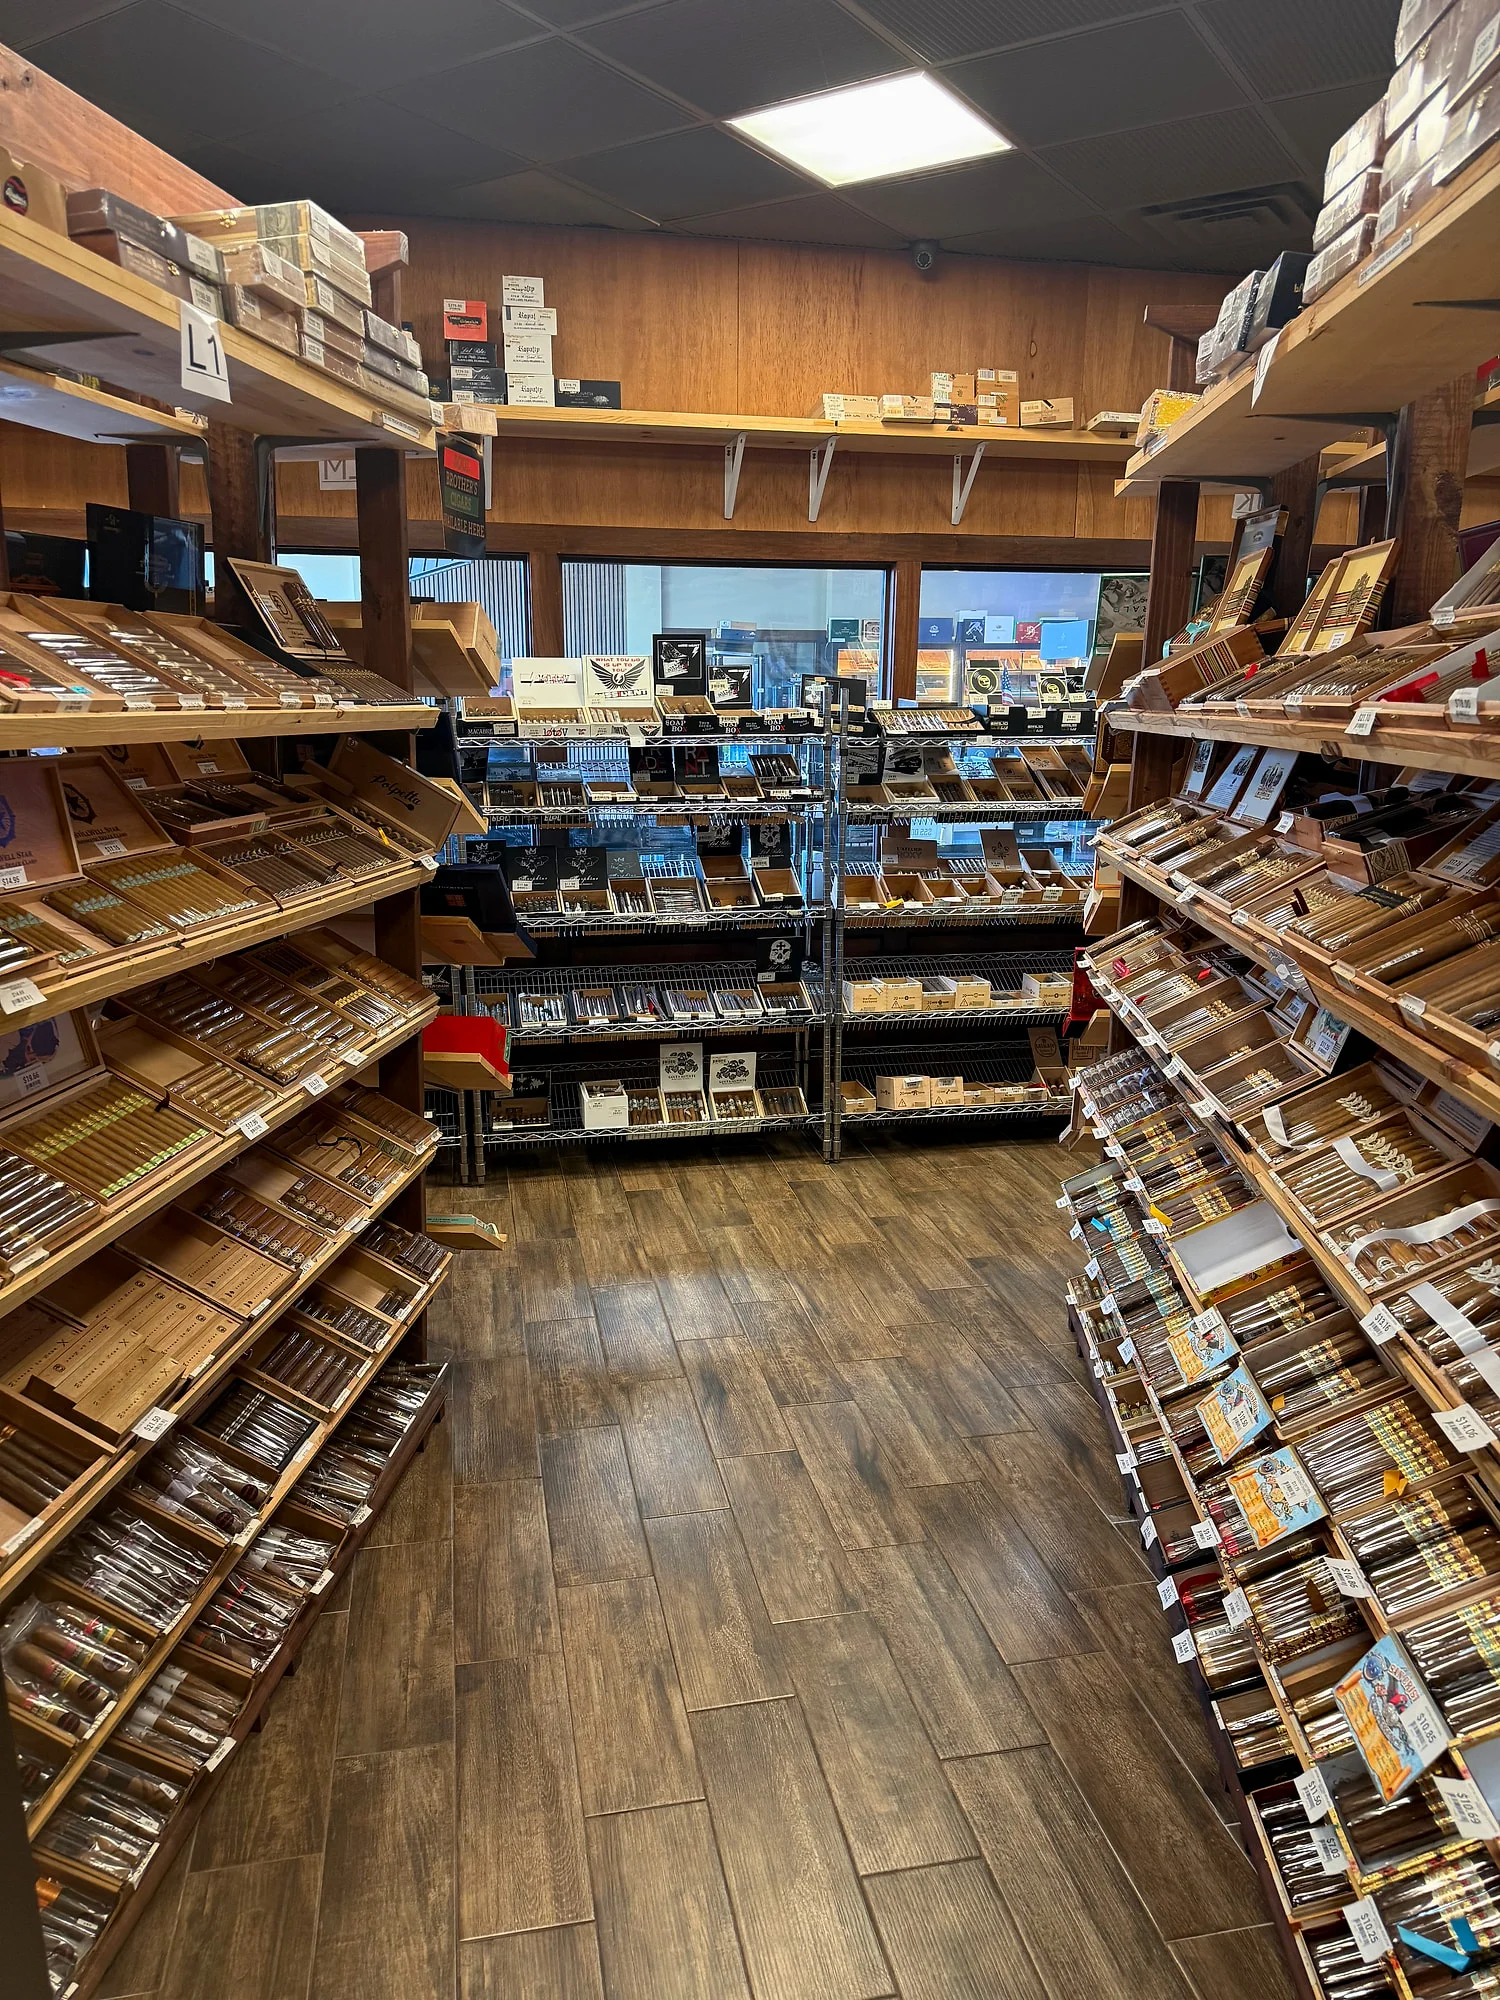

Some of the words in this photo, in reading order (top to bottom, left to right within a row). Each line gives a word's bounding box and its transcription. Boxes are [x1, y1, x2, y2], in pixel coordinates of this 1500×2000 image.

[188, 323, 220, 375] L1
[323, 458, 356, 480] M
[468, 520, 485, 538] HERE
[370, 775, 422, 806] Polpetta
[104, 825, 121, 834] STAR
[17, 850, 34, 859] STAR
[1, 876, 20, 887] $14.95
[22, 1071, 40, 1084] $19.66
[1374, 1313, 1392, 1332] $13.16
[144, 1415, 161, 1432] $21.50
[1455, 1415, 1479, 1439] $14.06
[1416, 1713, 1437, 1744] $10.85
[1307, 1780, 1322, 1805] $11.50
[1456, 1792, 1481, 1825] $10.69
[1326, 1836, 1341, 1859] $7.03
[1360, 1913, 1379, 1943] $10.25
